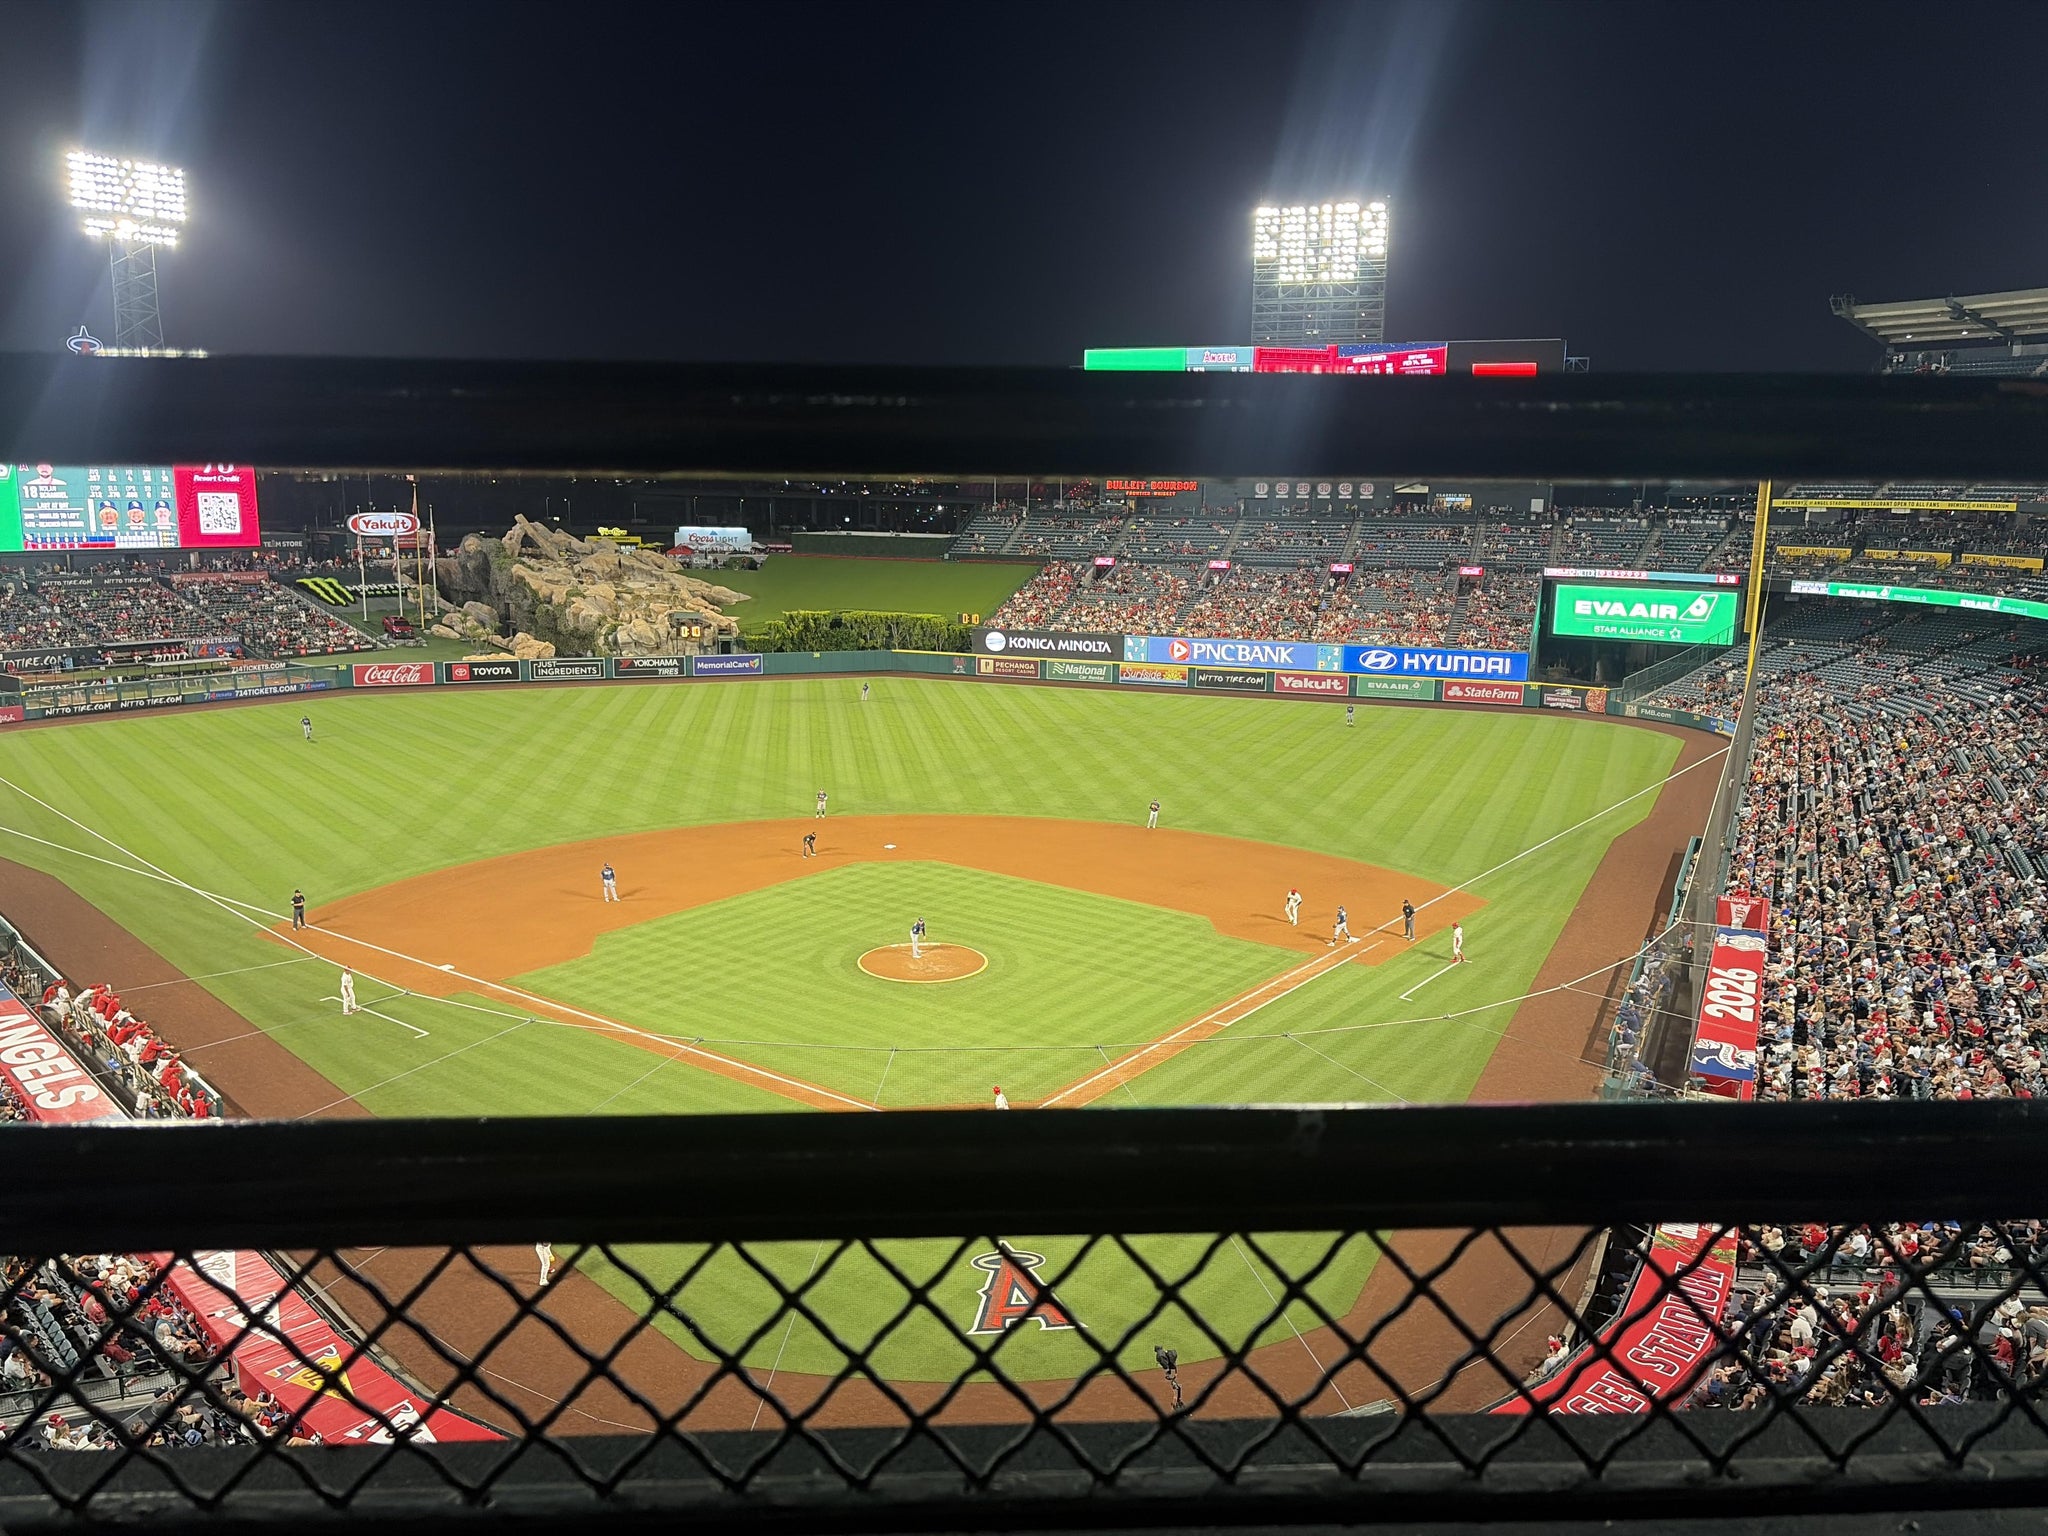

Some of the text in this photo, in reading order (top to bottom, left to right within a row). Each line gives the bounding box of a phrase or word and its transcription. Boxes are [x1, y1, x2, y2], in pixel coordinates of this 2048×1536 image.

[1203, 351, 1236, 362] ANGELS
[1106, 480, 1198, 491] BULLEIT BOURBON
[1340, 484, 1350, 492] 42
[23, 486, 38, 498] 18
[362, 520, 408, 530] Yakult
[688, 533, 714, 543] Coors
[1574, 600, 1678, 620] EVA AIR
[1594, 626, 1665, 637] STAR ALLIANCE
[1009, 637, 1112, 653] KONICA MINOLTA
[536, 660, 557, 668] JUST
[633, 658, 680, 668] YOKOHAMA
[697, 660, 750, 670] MemorialCare
[996, 662, 1035, 670] PECHANGA
[1404, 652, 1511, 674] HYUNDAI
[364, 664, 424, 684] Coca-Cola
[472, 667, 512, 676] TOYOTA
[538, 666, 598, 676] INGREDIENTS
[658, 668, 679, 676] TIRES
[1065, 664, 1106, 676] National
[1124, 668, 1162, 680] Surfside
[1198, 674, 1264, 685] NITTO TIRE.COM
[1280, 676, 1342, 690] Yakult
[235, 684, 297, 697] 714TICKETS.COM
[120, 696, 182, 708] NITTO TIRE.COM
[46, 702, 111, 716] NITTO TIRE.COM
[1641, 709, 1672, 719] FMB.com
[1704, 966, 1760, 1022] 2026
[966, 1240, 1088, 1334] A
